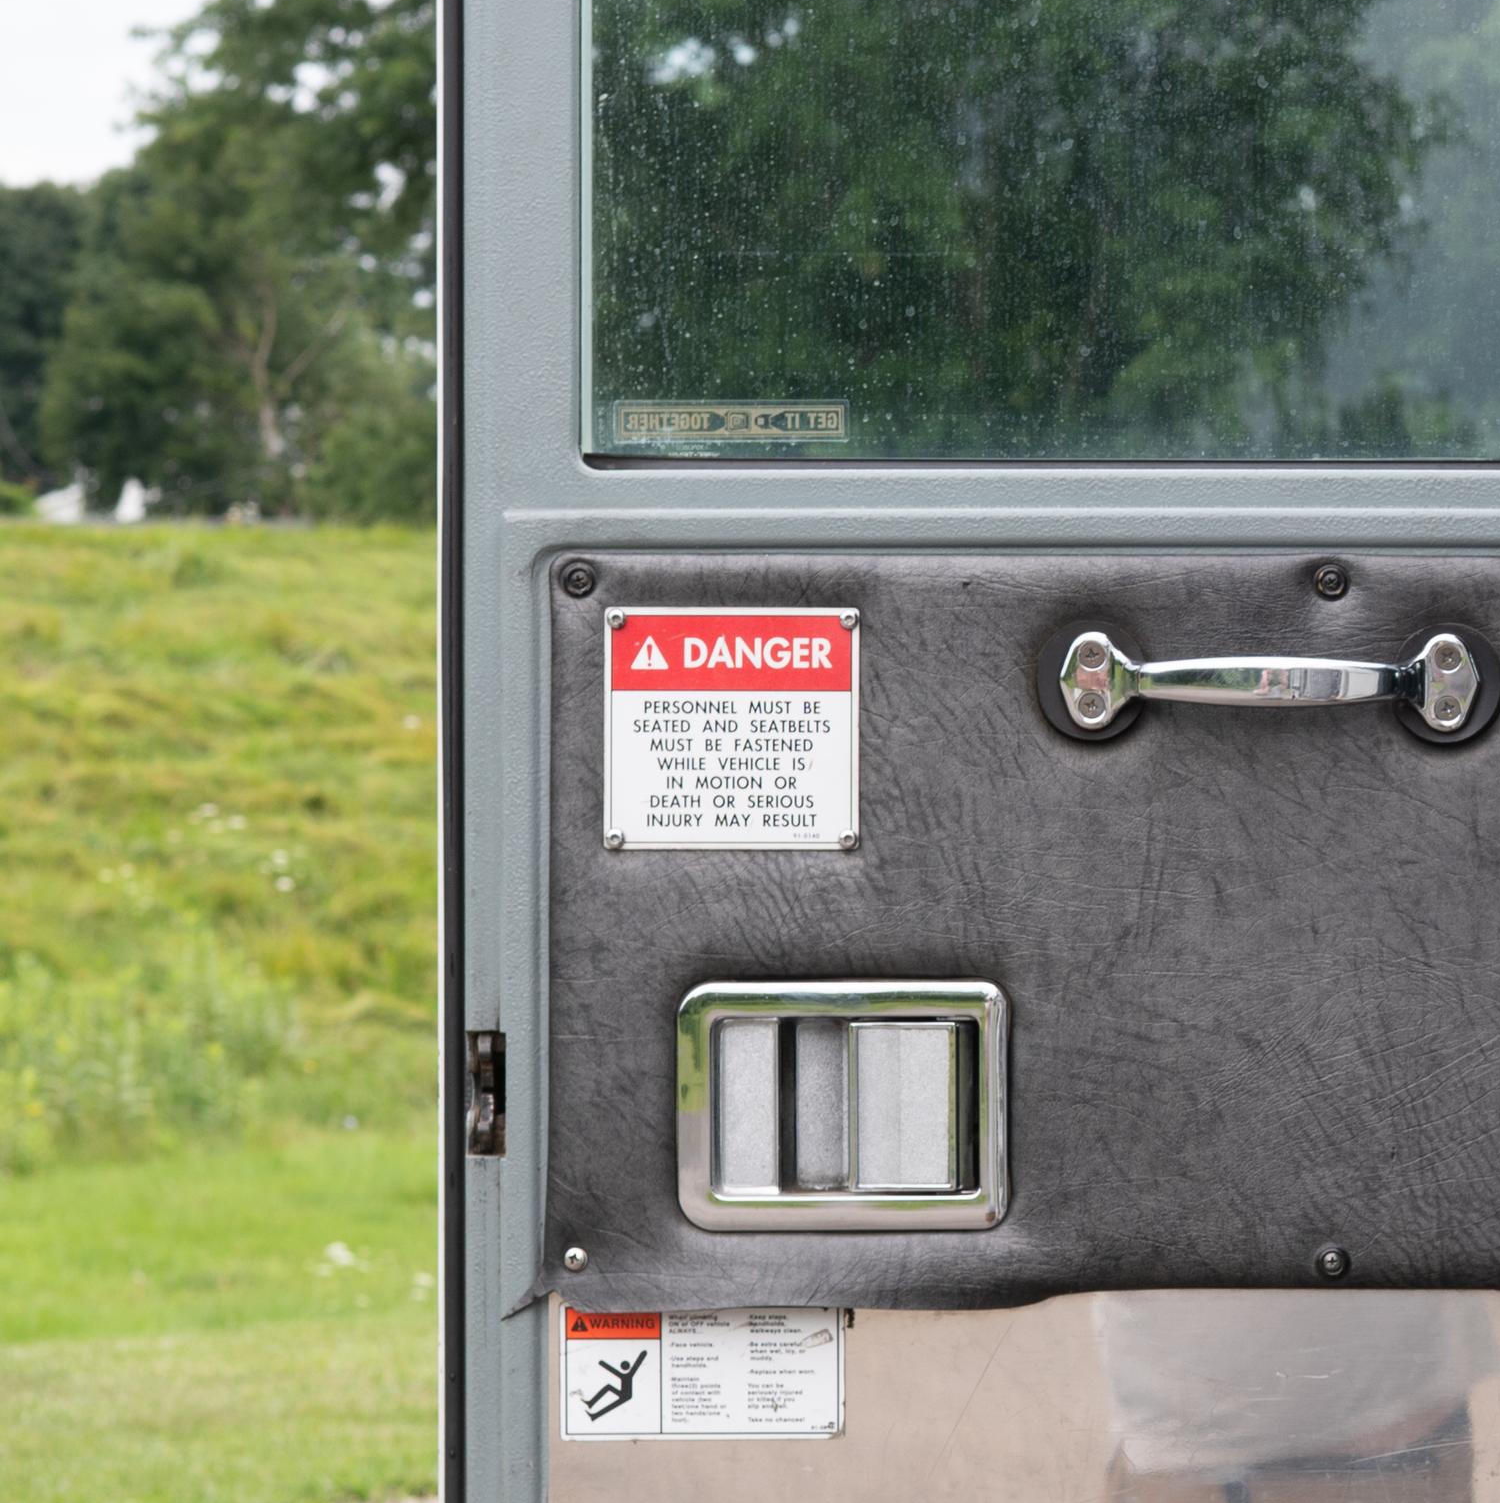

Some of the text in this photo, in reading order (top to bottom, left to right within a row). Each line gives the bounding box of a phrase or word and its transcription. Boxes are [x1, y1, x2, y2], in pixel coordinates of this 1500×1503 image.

[682, 636, 832, 669] DANGER
[644, 701, 821, 714] PERSONNEL MUST BE
[633, 720, 831, 733] SEATED AND SEATBELTS
[650, 739, 814, 752] MUST BE FASTENED
[657, 757, 806, 771] WHILE VEHICLE IS
[666, 776, 797, 789] IN MOTION OR
[650, 795, 814, 808] DEATH OR SERIOUS
[646, 813, 817, 827] INJURY MAY RESULT
[589, 1317, 656, 1330] WARNING
